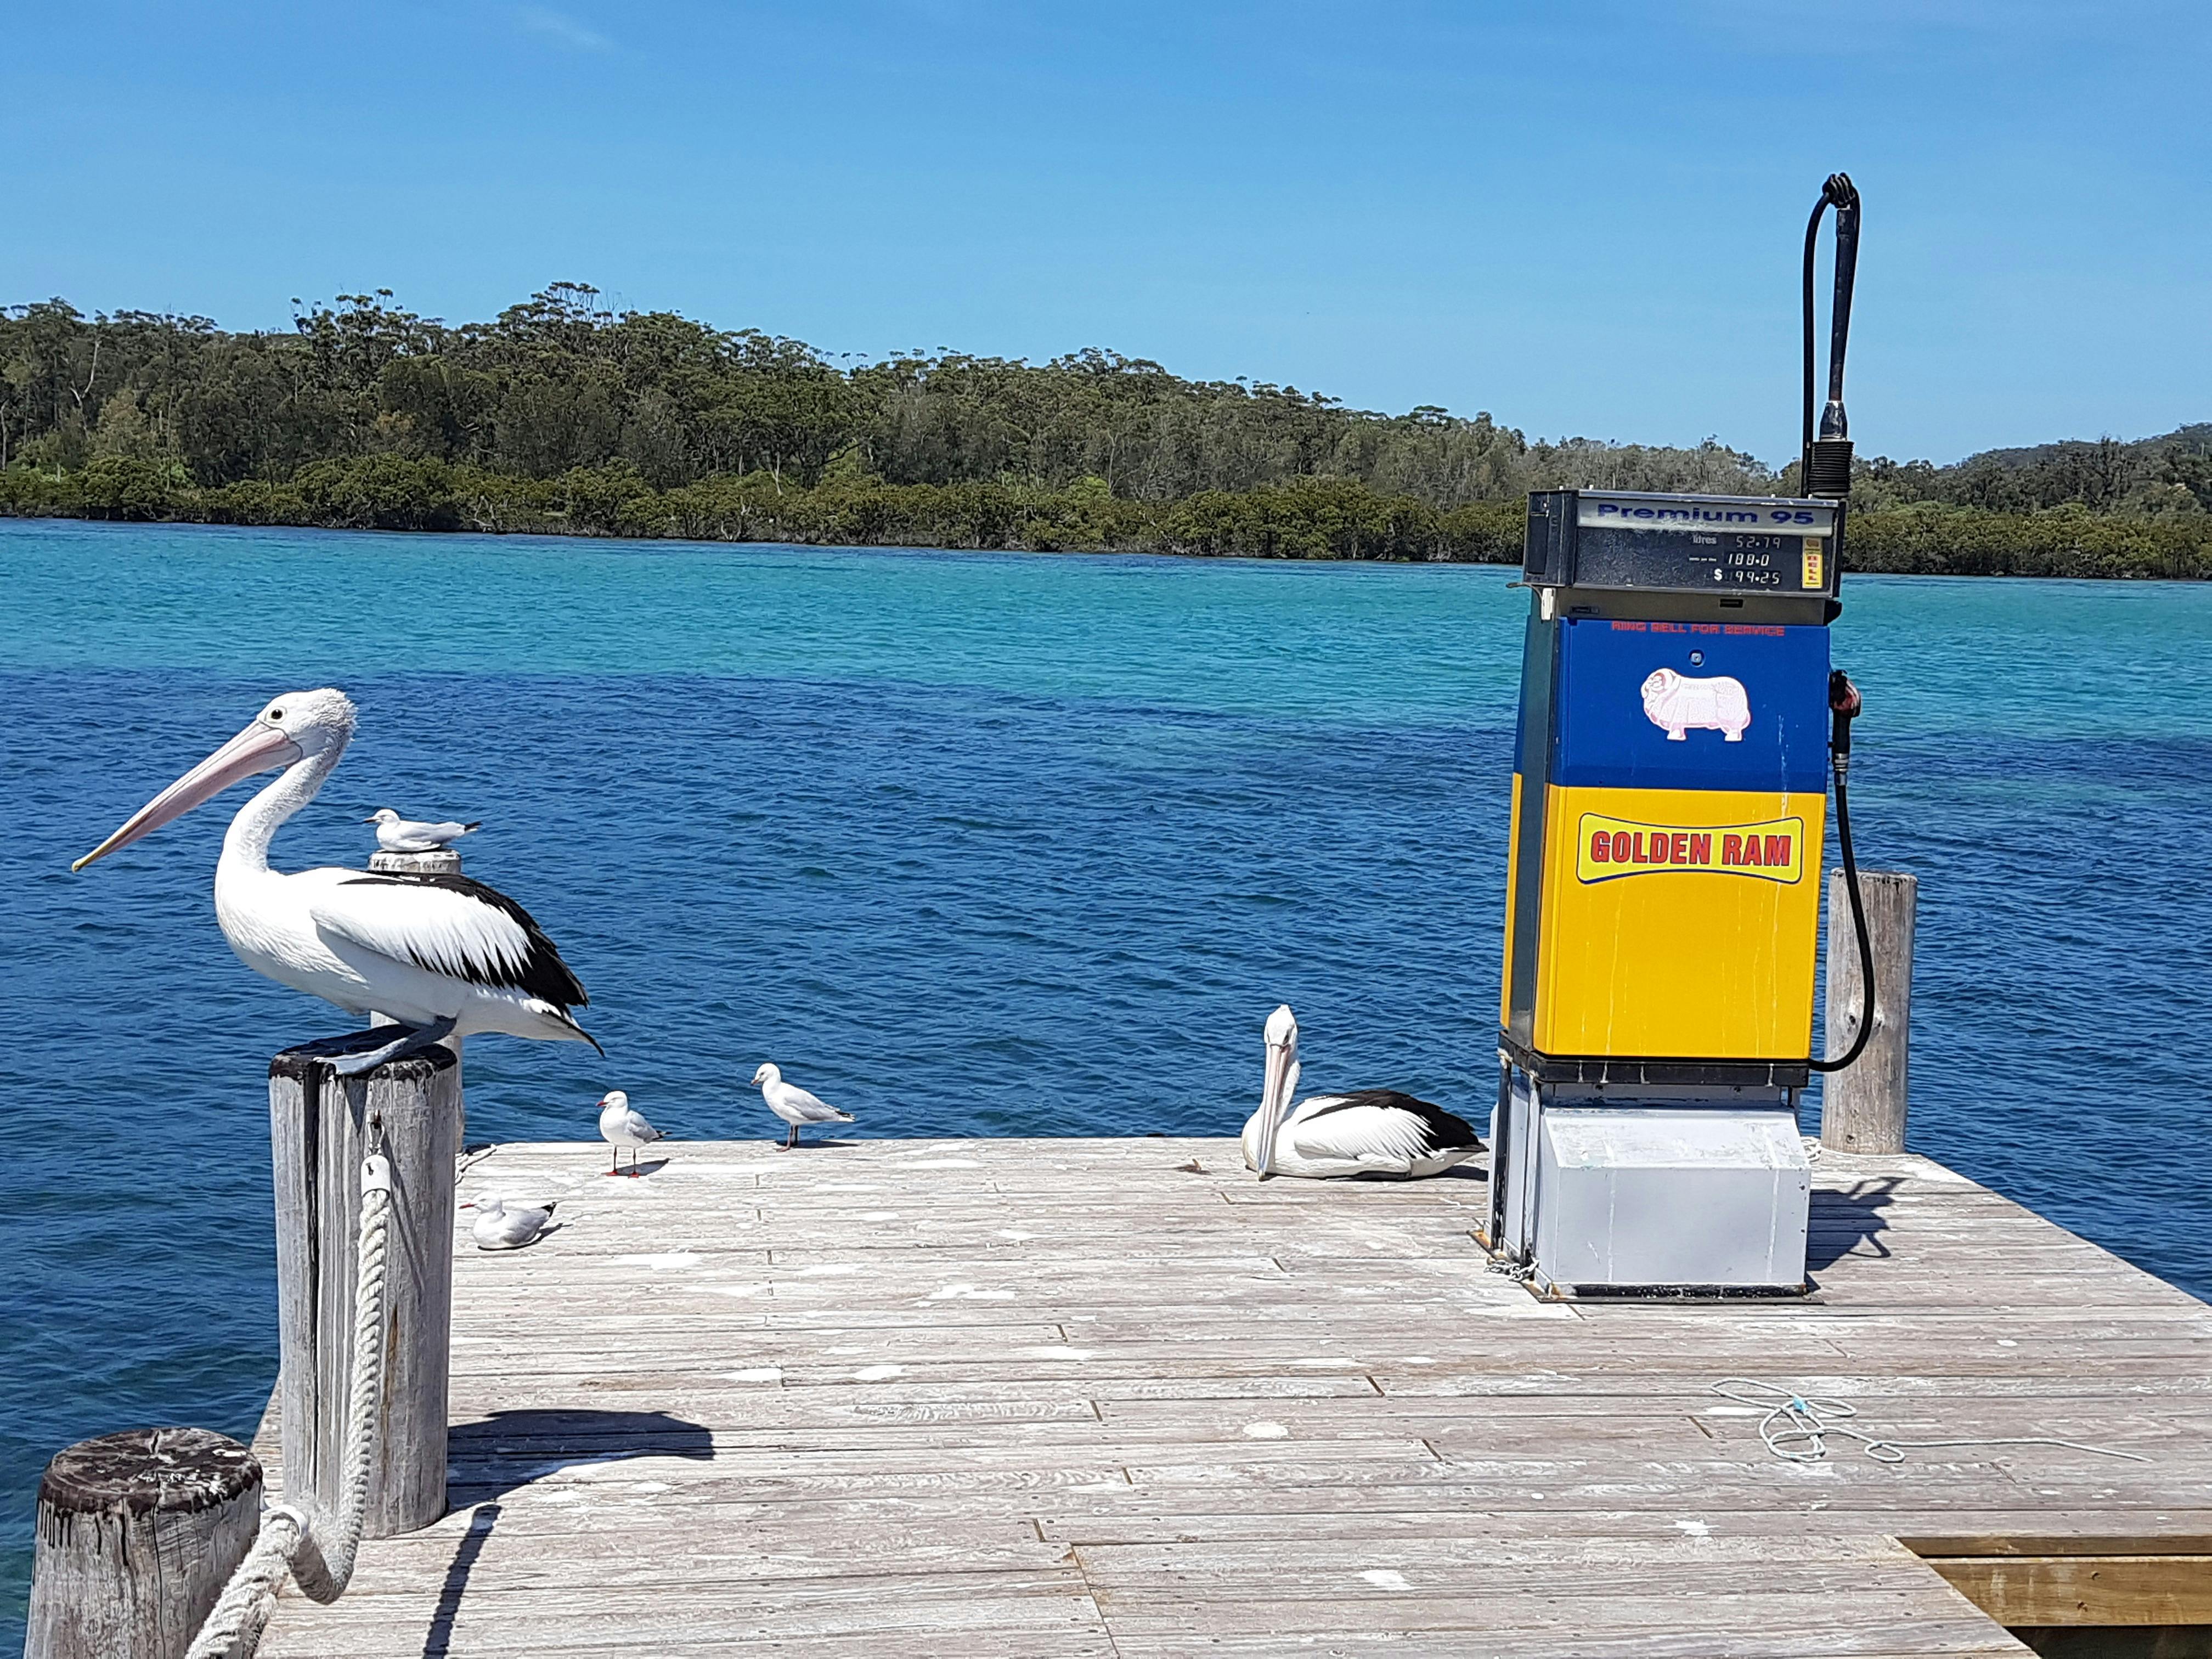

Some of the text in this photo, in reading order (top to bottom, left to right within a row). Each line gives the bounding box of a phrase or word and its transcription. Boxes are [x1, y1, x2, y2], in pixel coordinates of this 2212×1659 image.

[1598, 504, 1814, 525] Premium 95
[1611, 621, 1785, 637] RING BELL FOR SERVICE
[1590, 830, 1791, 867] GOLDEN RAM
